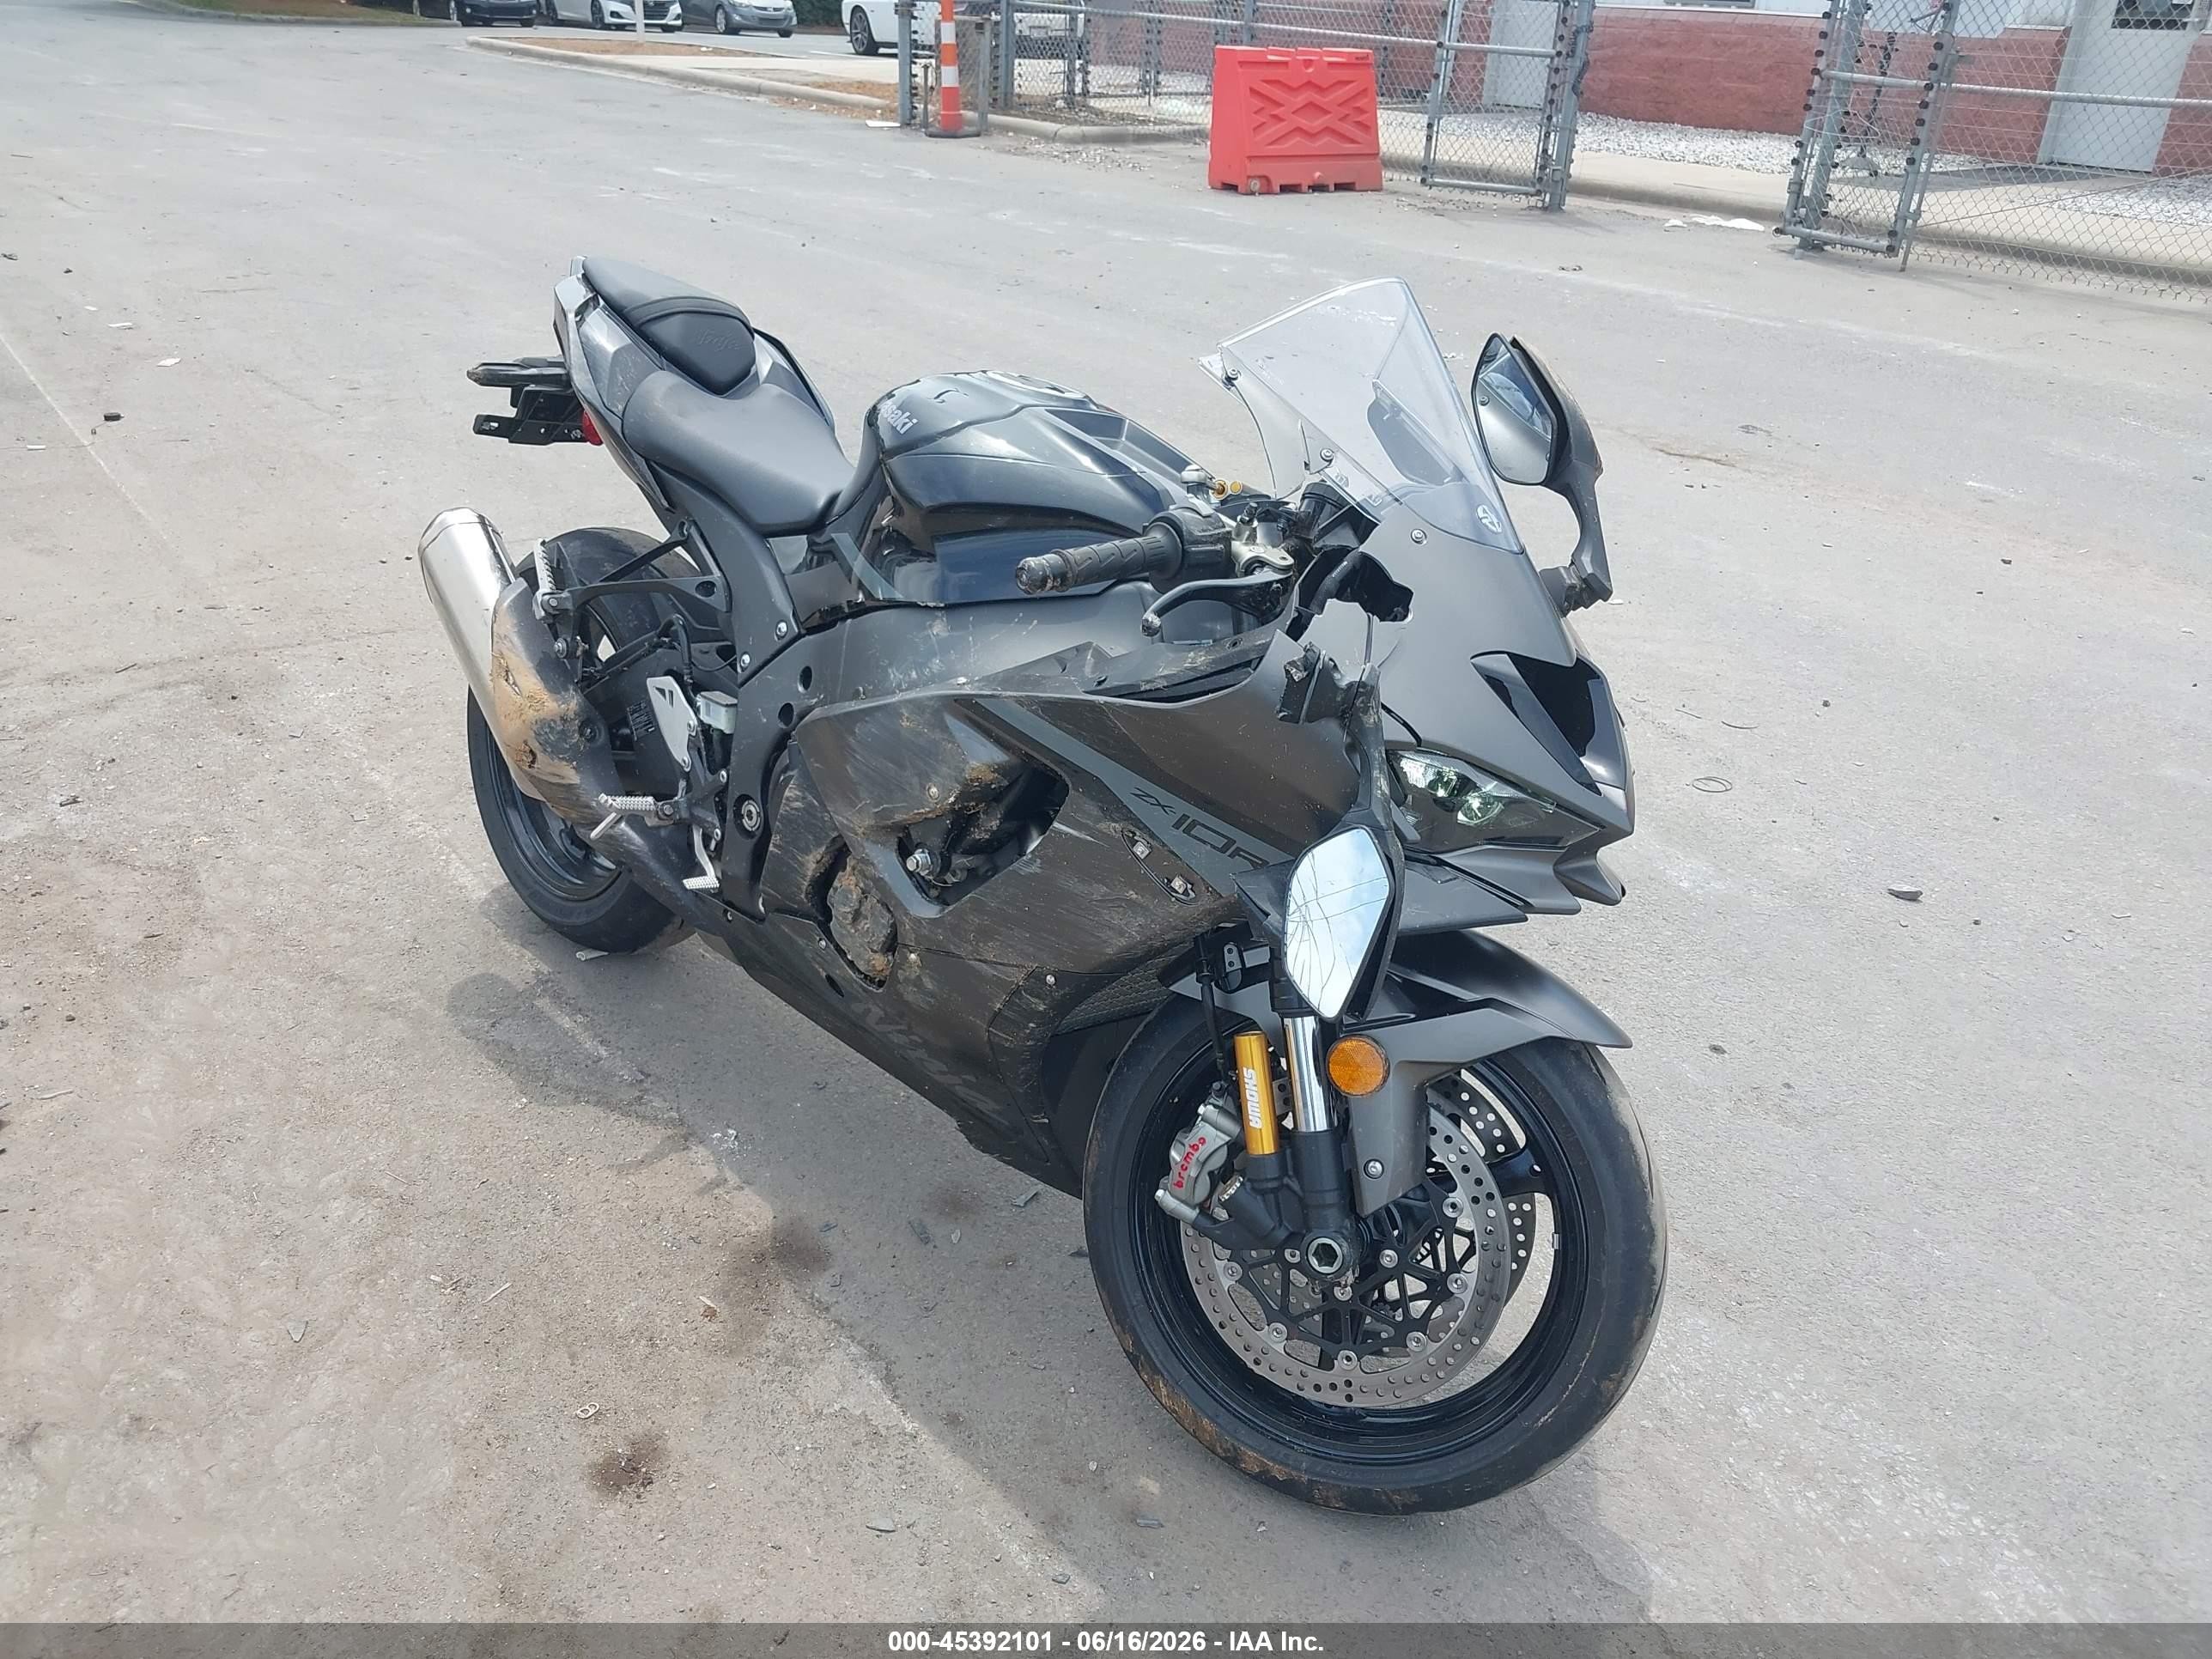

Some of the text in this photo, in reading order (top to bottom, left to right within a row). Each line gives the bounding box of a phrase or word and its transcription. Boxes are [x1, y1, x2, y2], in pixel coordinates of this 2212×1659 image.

[1129, 787, 1270, 870] ZX-10R
[1243, 1066, 1262, 1129] SHOWA
[1173, 1136, 1206, 1189] brembo
